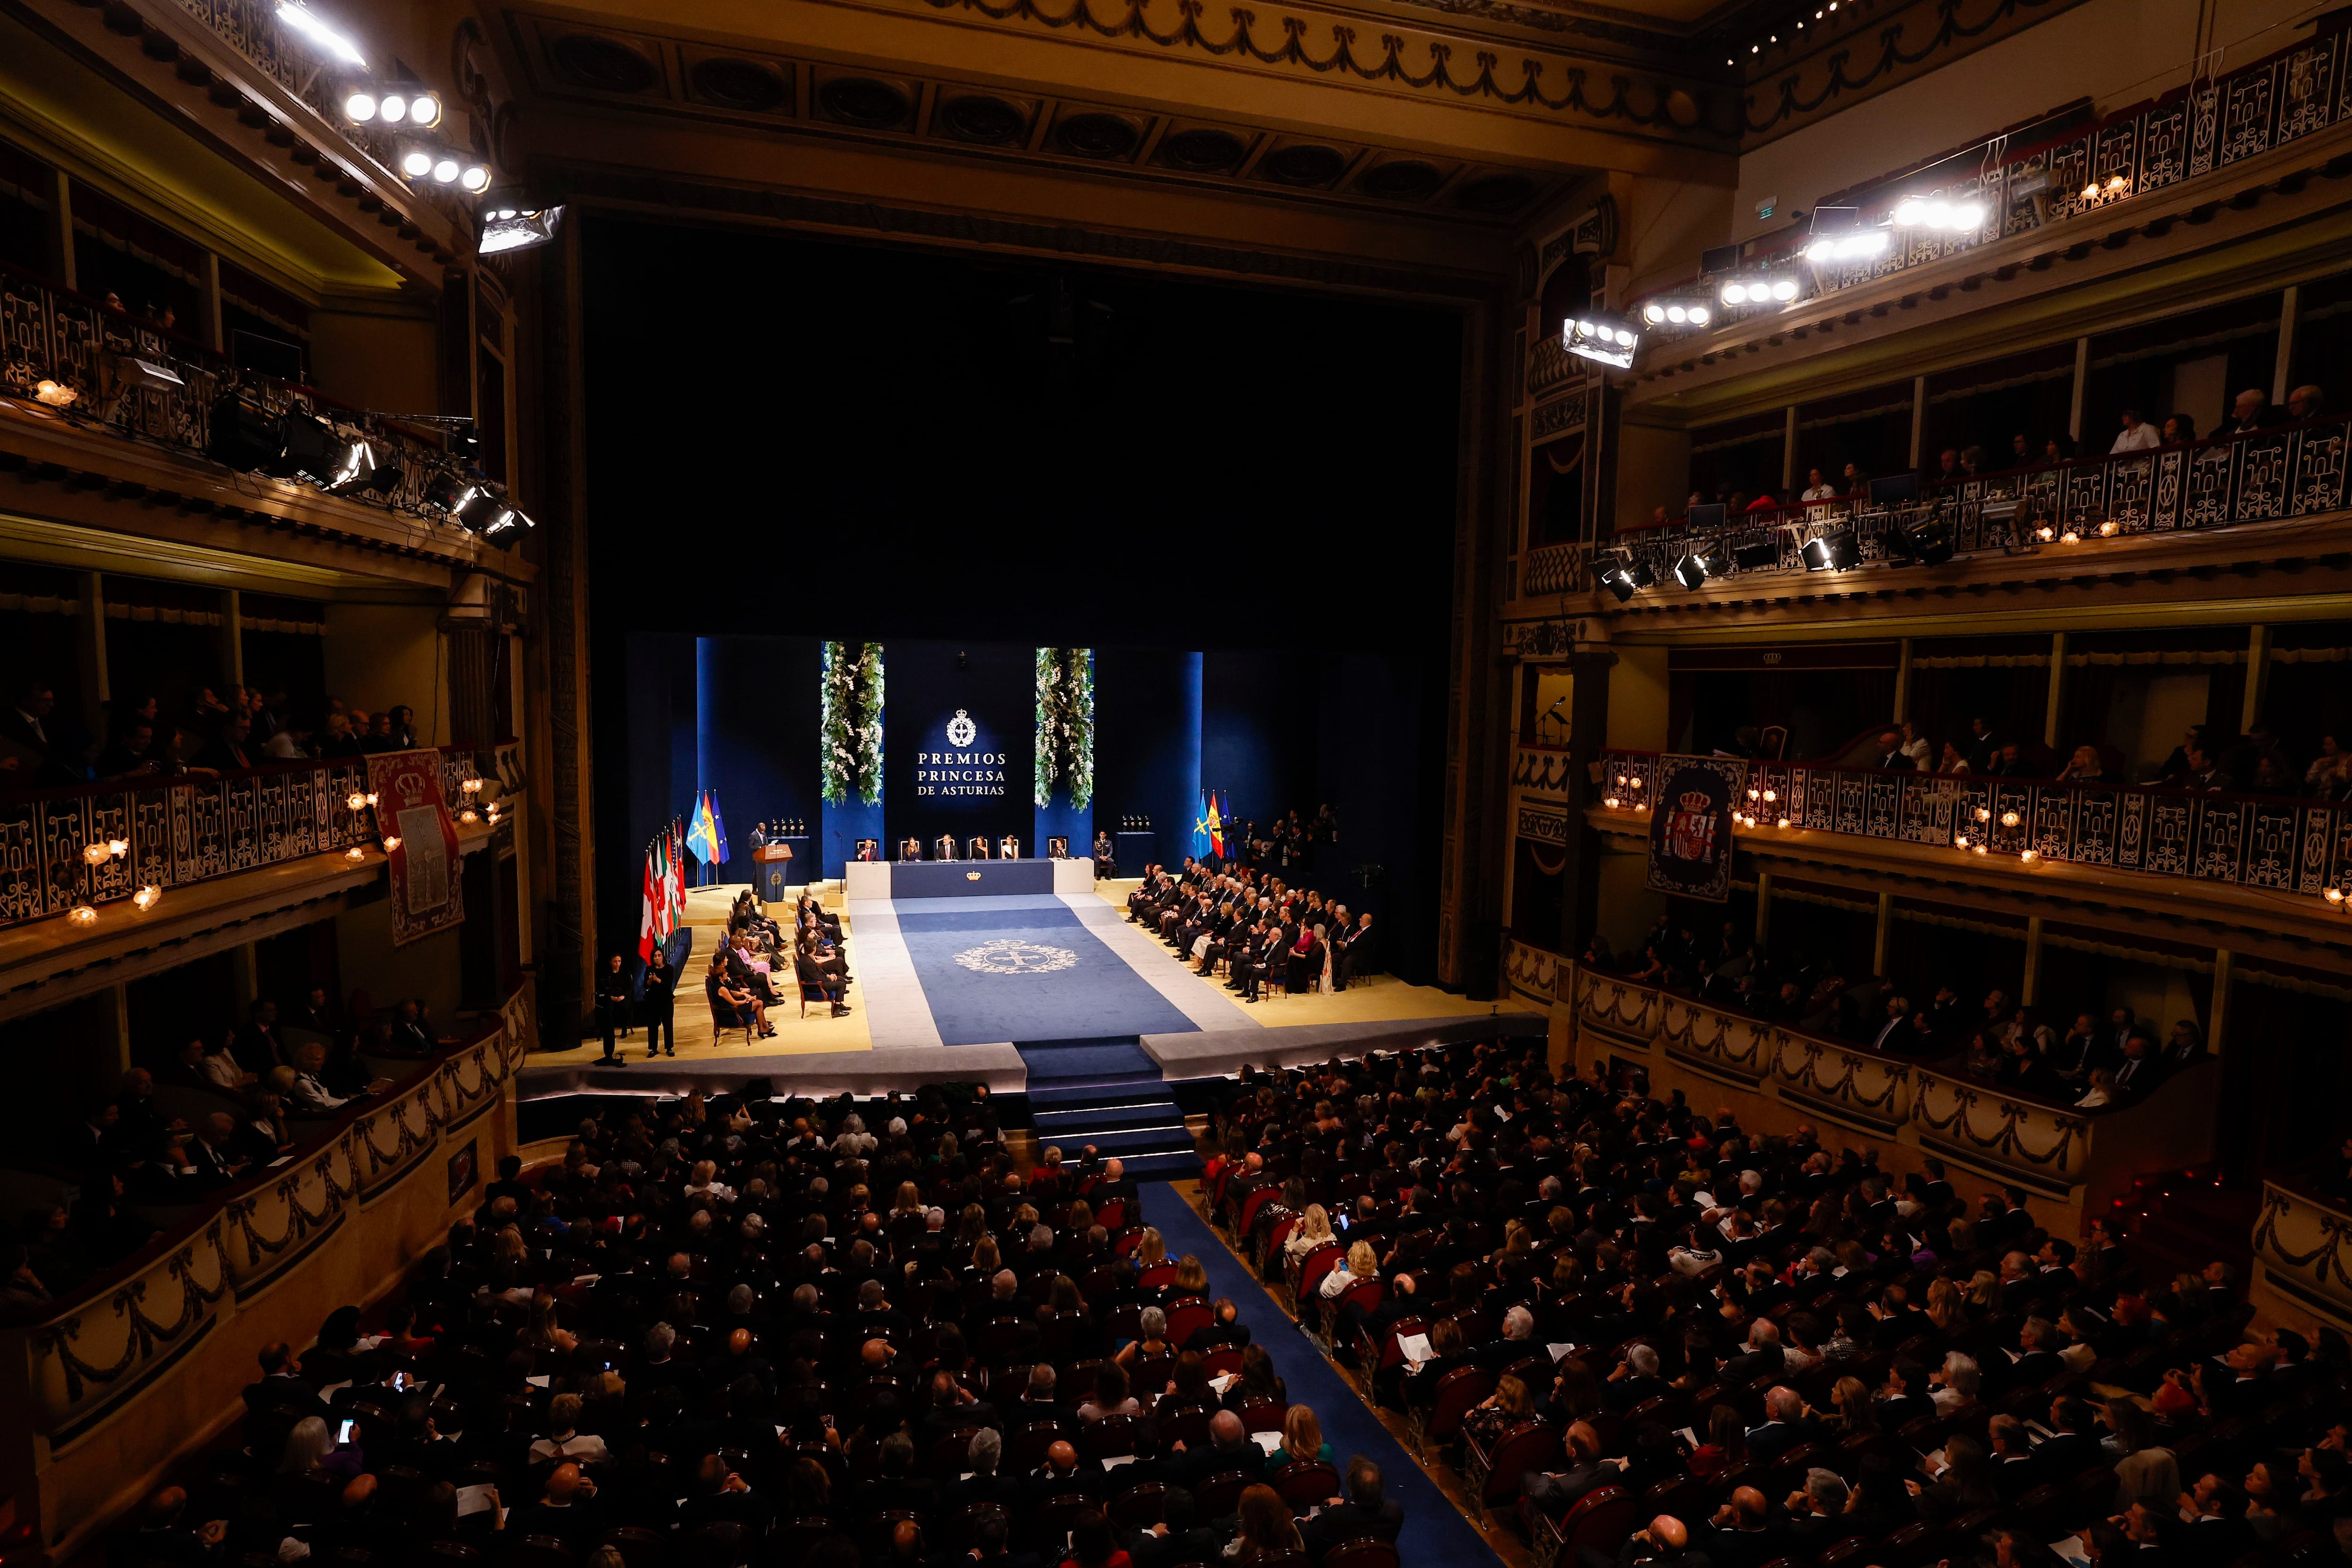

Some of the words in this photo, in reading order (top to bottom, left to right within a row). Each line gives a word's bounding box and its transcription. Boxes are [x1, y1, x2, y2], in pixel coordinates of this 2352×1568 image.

[918, 753, 1006, 765] PREMIOS
[918, 770, 1005, 781] PRINCESA
[918, 786, 935, 795] DE
[941, 786, 1004, 795] ASTURIAS
